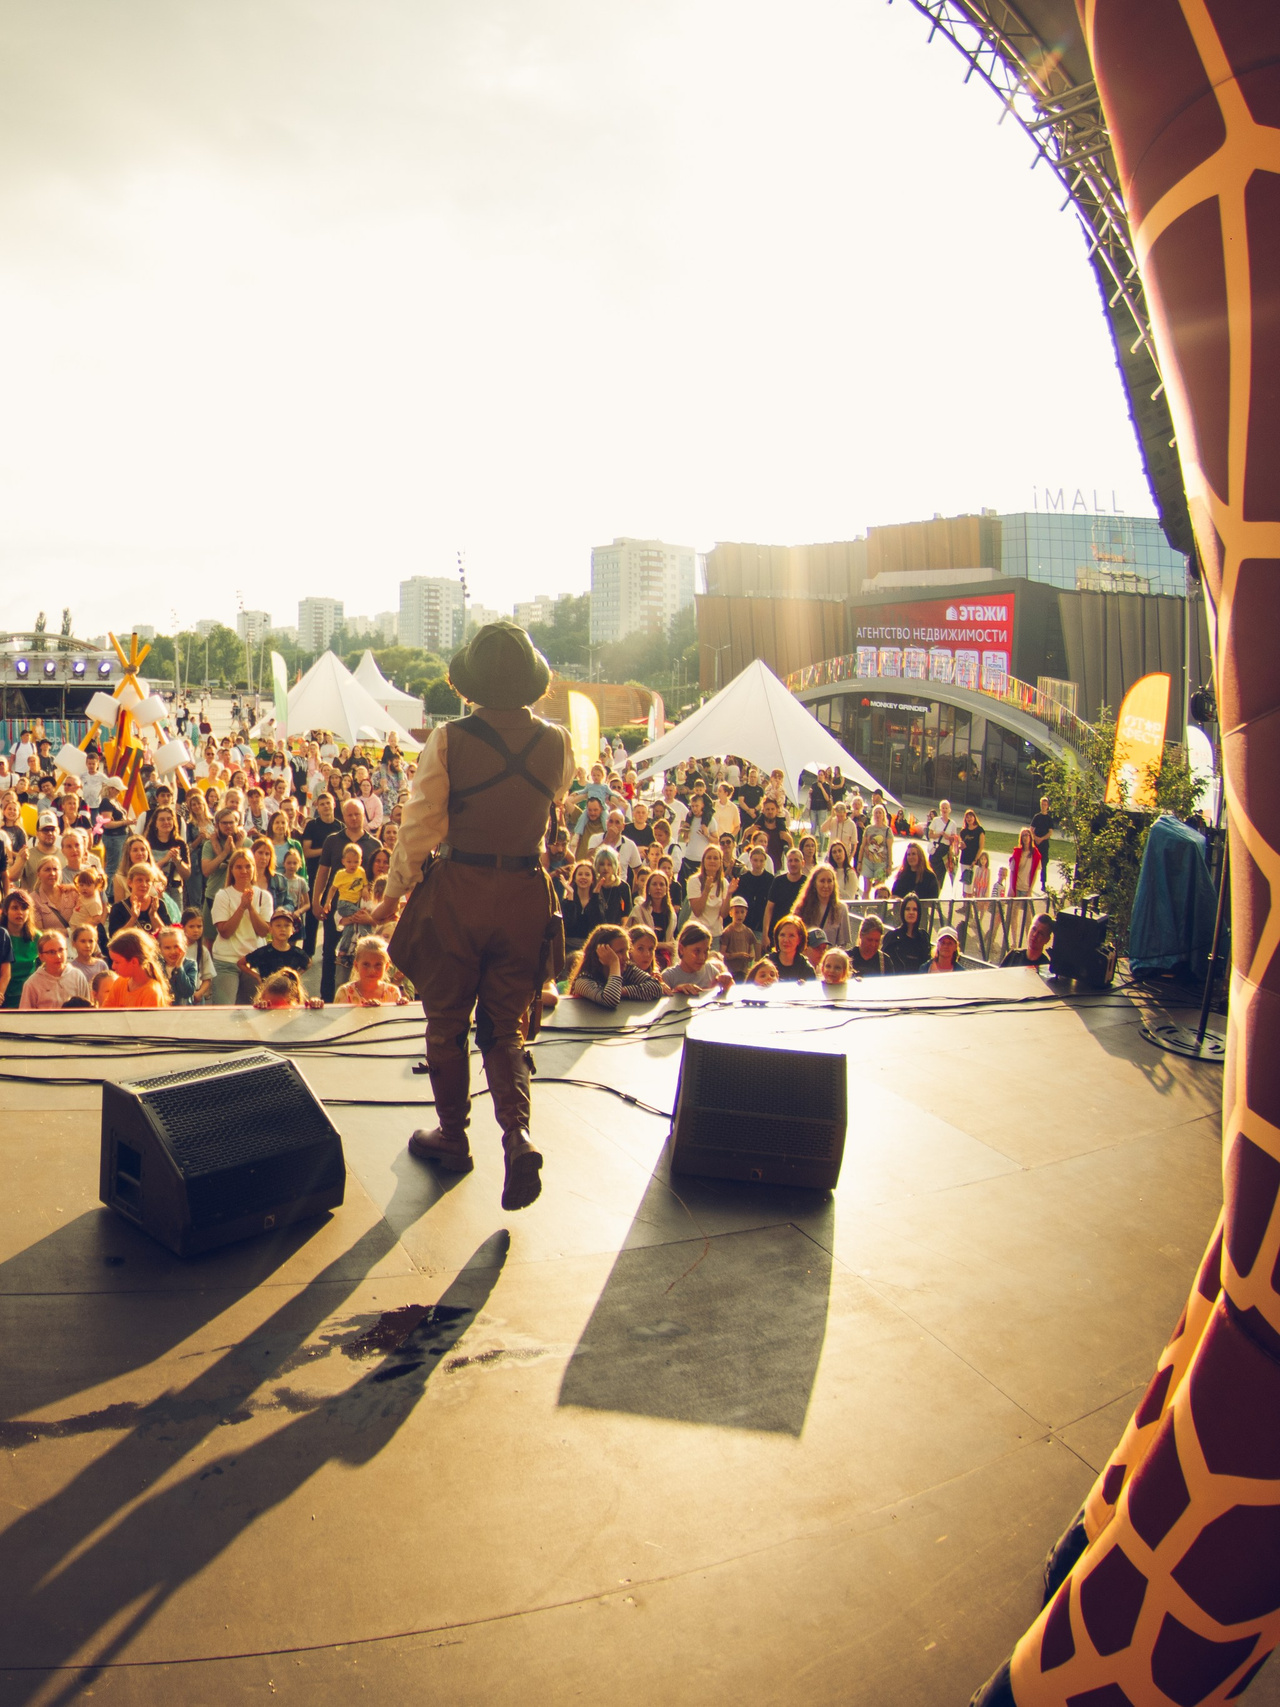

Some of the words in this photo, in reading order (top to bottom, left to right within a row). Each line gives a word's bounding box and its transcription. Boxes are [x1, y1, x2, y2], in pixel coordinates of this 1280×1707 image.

[1033, 485, 1124, 513] iMALL
[856, 627, 910, 639] АГЕНТСТВО
[913, 628, 1007, 642] НЕДВИЖИМОСТИ
[870, 701, 898, 709] MONKEY
[898, 704, 928, 712] GRINDER
[1122, 727, 1161, 746] ФЕСТ
